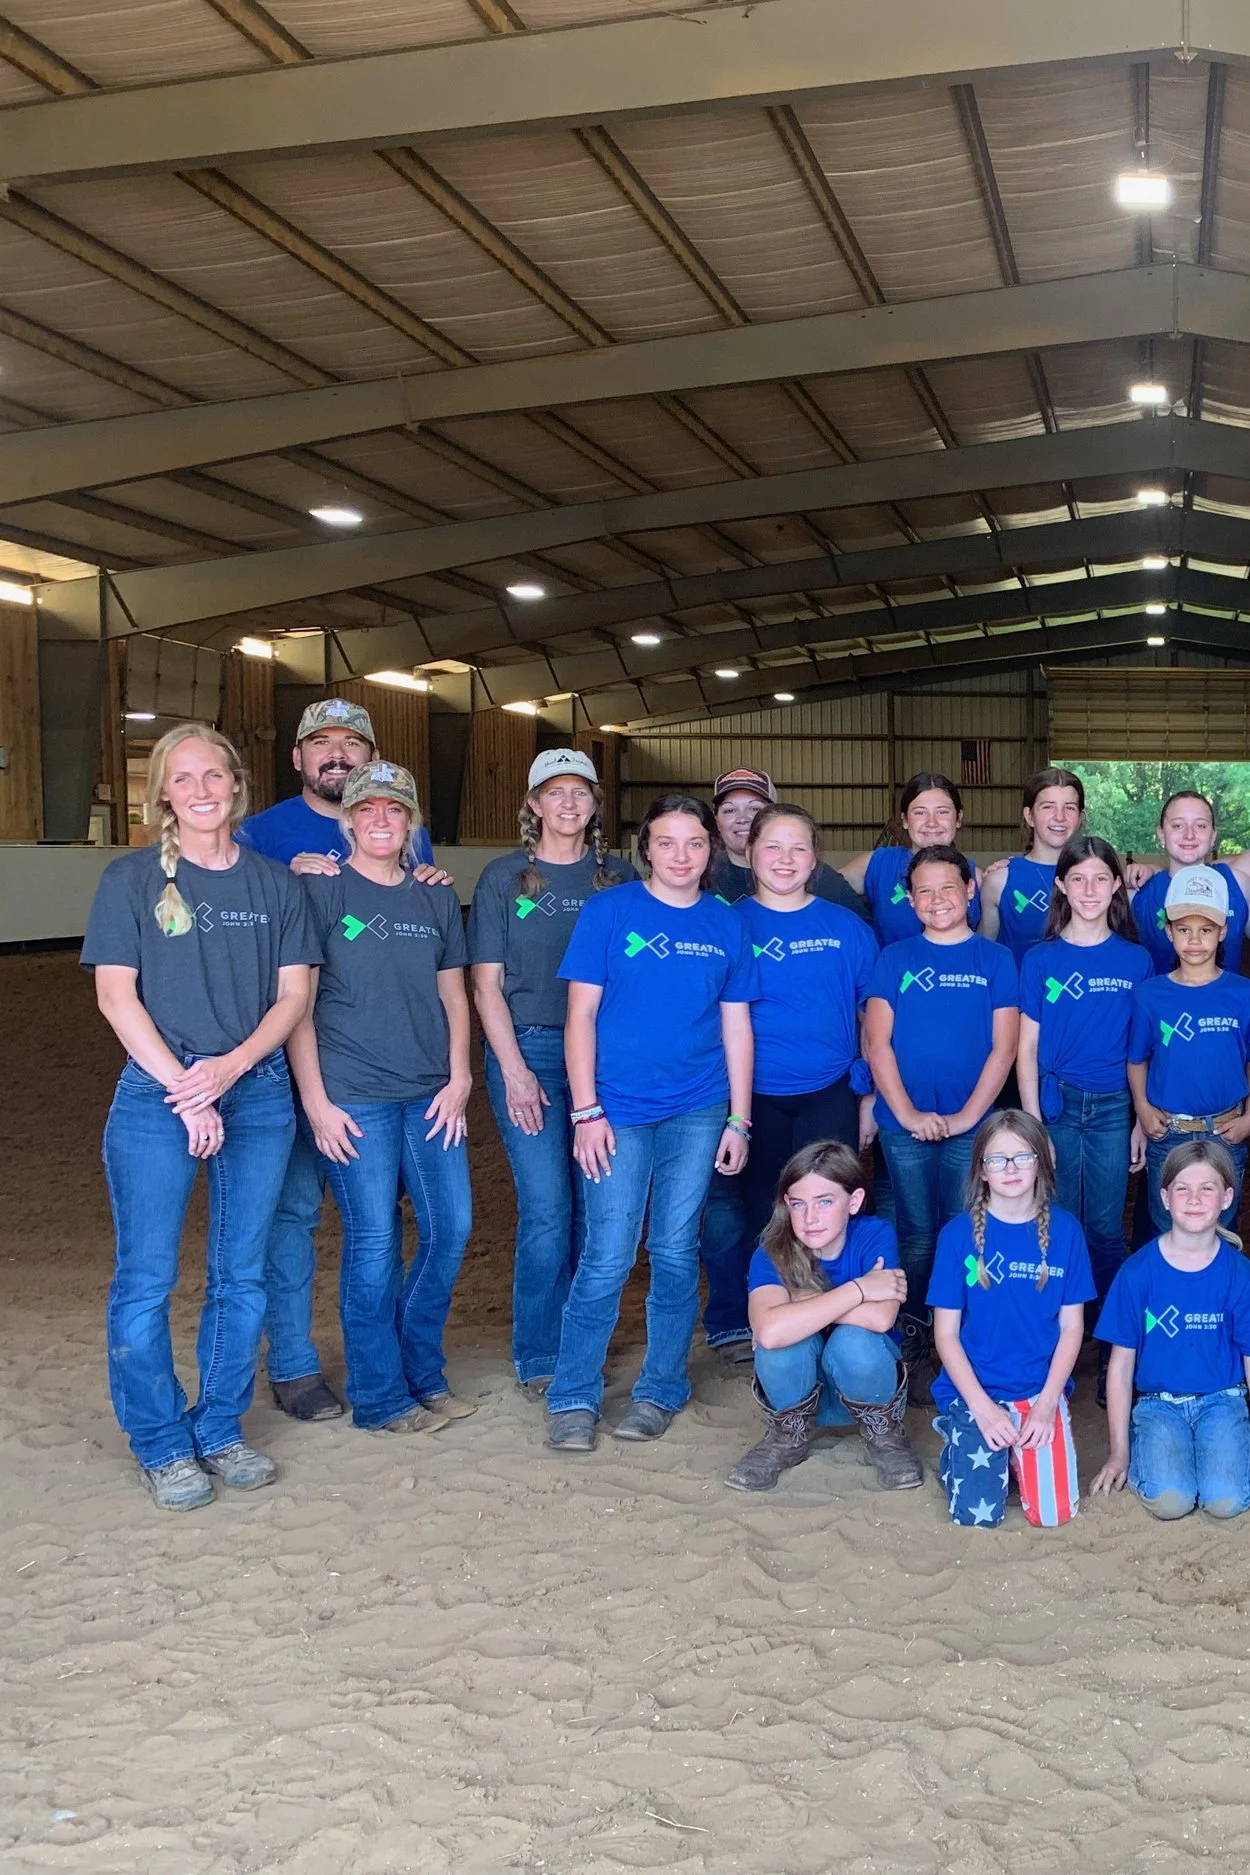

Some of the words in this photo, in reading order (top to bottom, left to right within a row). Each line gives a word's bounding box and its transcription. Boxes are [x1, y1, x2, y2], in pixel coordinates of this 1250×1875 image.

[220, 911, 271, 924] GREATE
[675, 942, 725, 957] GREATER
[789, 938, 841, 950] GREATER
[939, 974, 987, 986] GREATER
[1198, 1017, 1240, 1029] GREATE
[1009, 1261, 1064, 1278] GREAER
